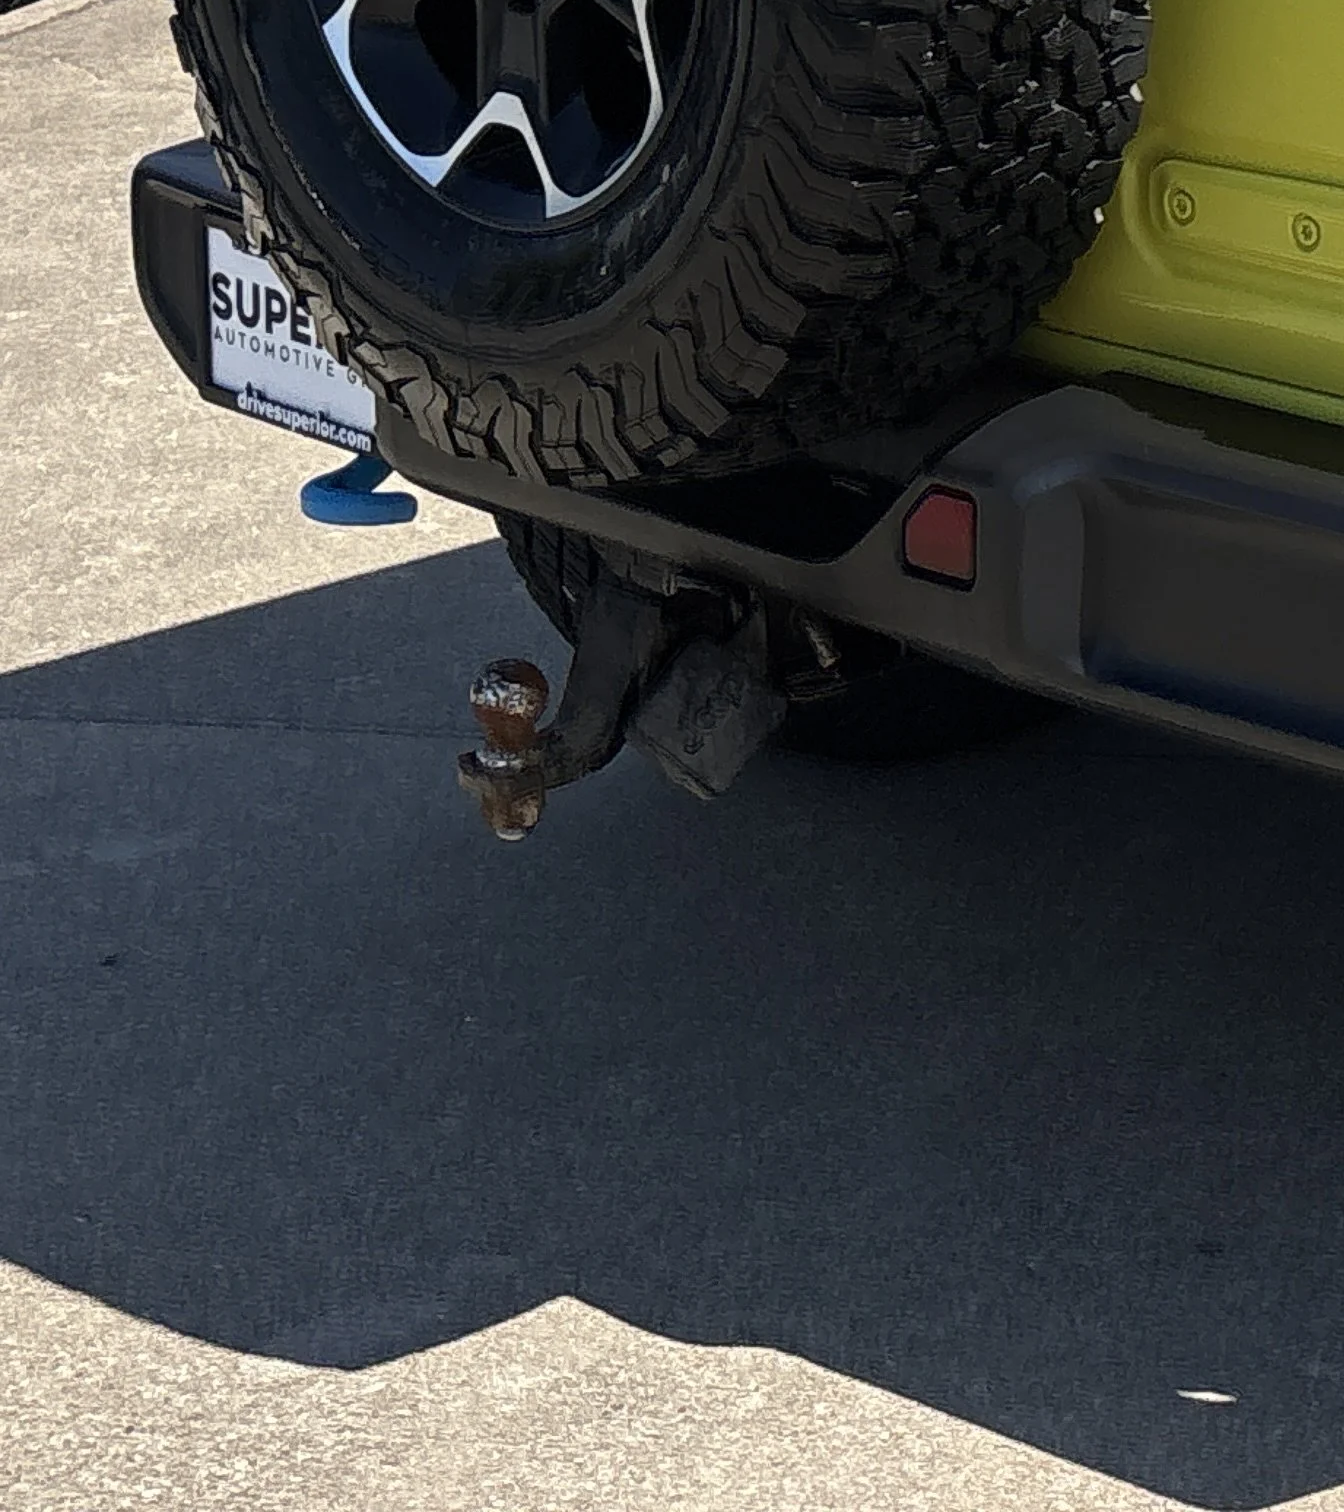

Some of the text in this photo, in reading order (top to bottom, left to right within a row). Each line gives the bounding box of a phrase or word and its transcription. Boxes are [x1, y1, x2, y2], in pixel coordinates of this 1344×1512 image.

[212, 272, 323, 349] SUPE
[214, 326, 335, 377] AUTOMOTIVE
[237, 389, 372, 452] drivesuperior.com
